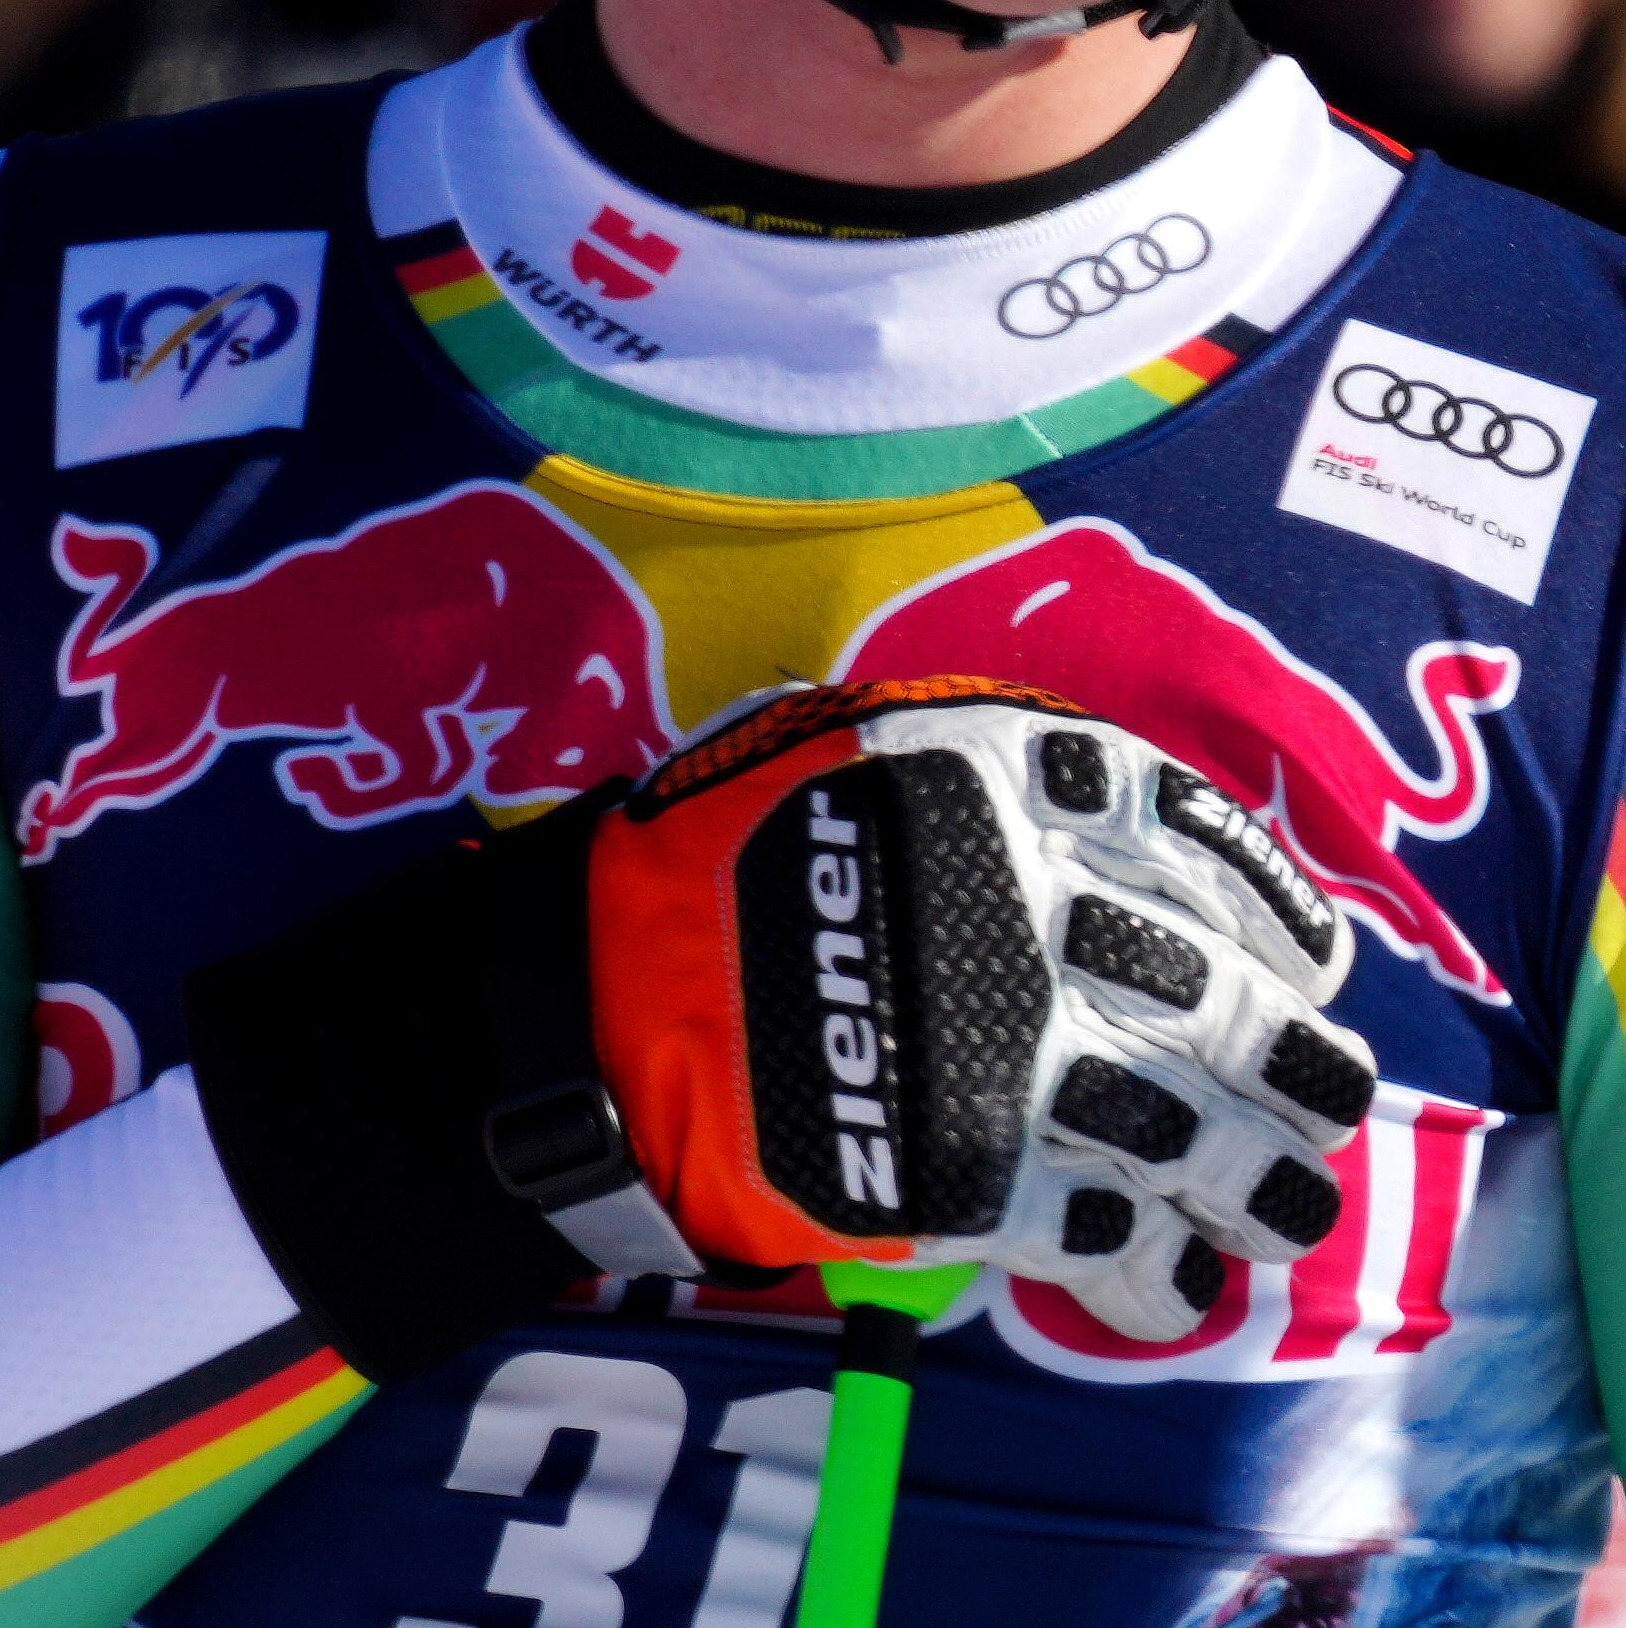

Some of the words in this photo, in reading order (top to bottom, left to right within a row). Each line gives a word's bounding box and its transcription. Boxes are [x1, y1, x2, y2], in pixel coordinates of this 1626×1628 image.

[1313, 458, 1351, 480] FIS
[1357, 474, 1393, 494] Ski
[1401, 485, 1475, 525] World
[1482, 520, 1526, 549] Cup
[1319, 442, 1377, 469] Audi
[1179, 788, 1333, 927] ziener
[809, 790, 901, 1210] ziener
